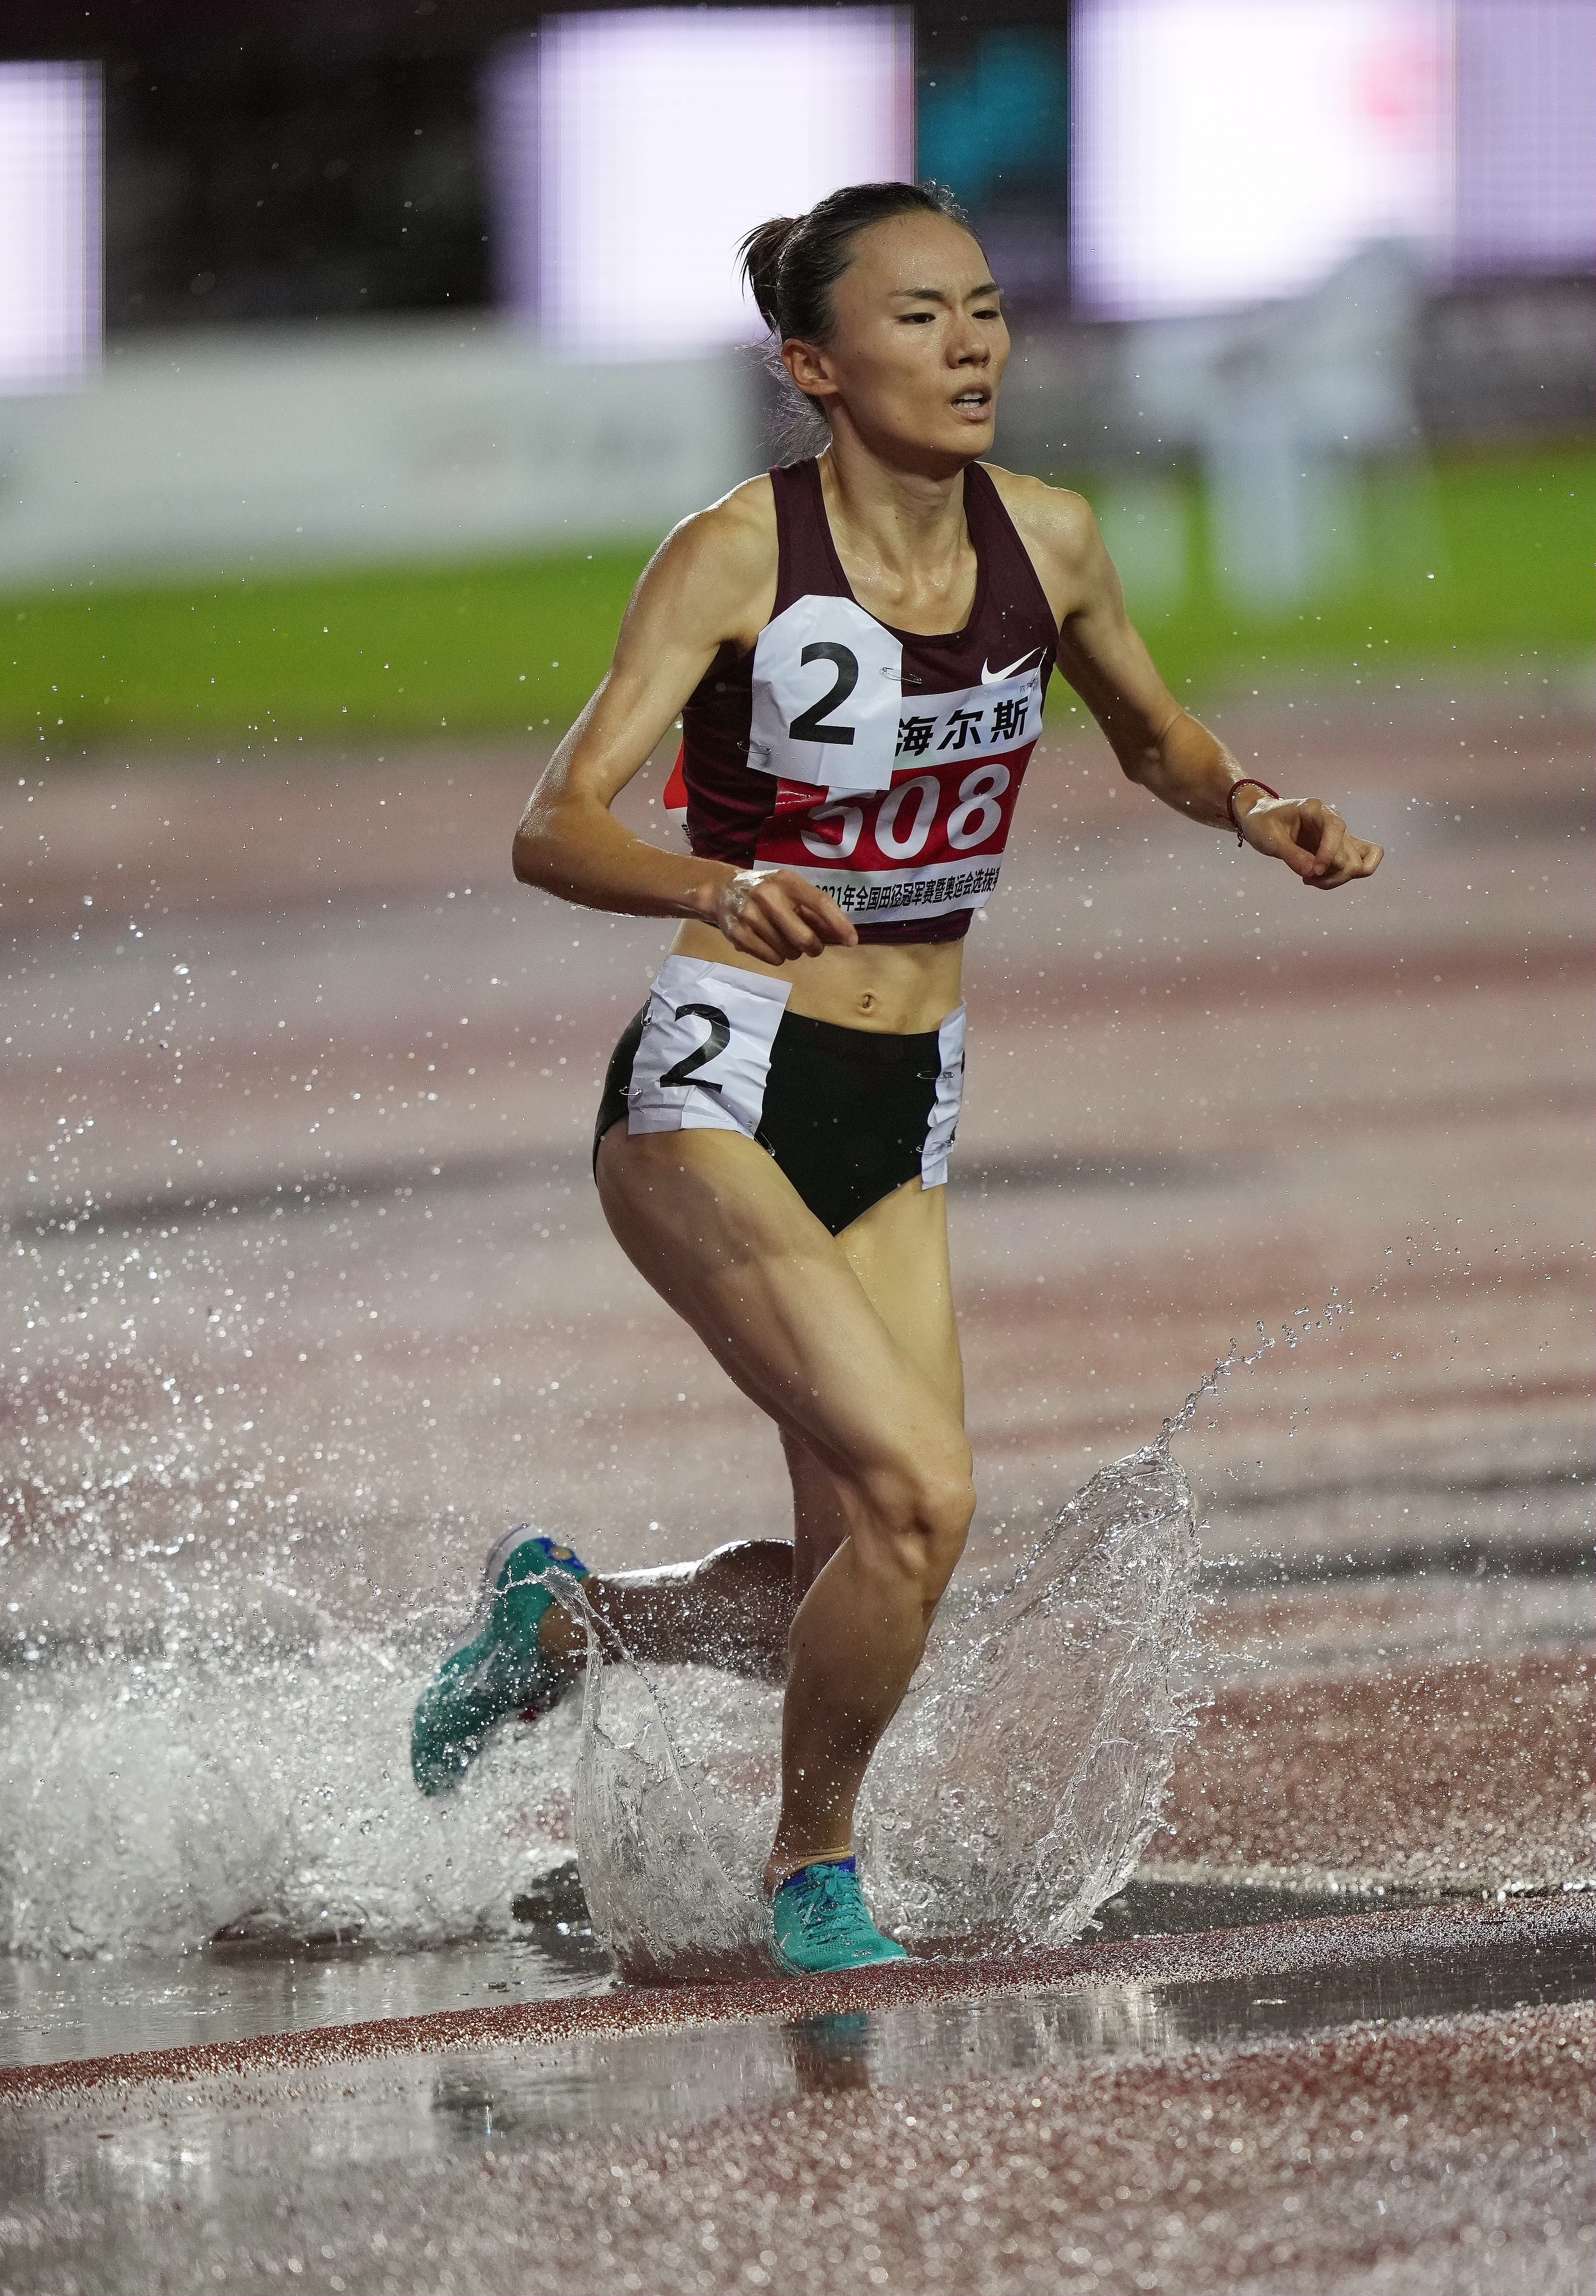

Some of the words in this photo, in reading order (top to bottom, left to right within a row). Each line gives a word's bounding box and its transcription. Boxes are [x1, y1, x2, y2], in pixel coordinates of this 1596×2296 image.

[789, 642, 859, 745] 2
[895, 695, 1029, 756] 海尔斯
[801, 763, 1010, 860] 508
[659, 1003, 730, 1094] 2
